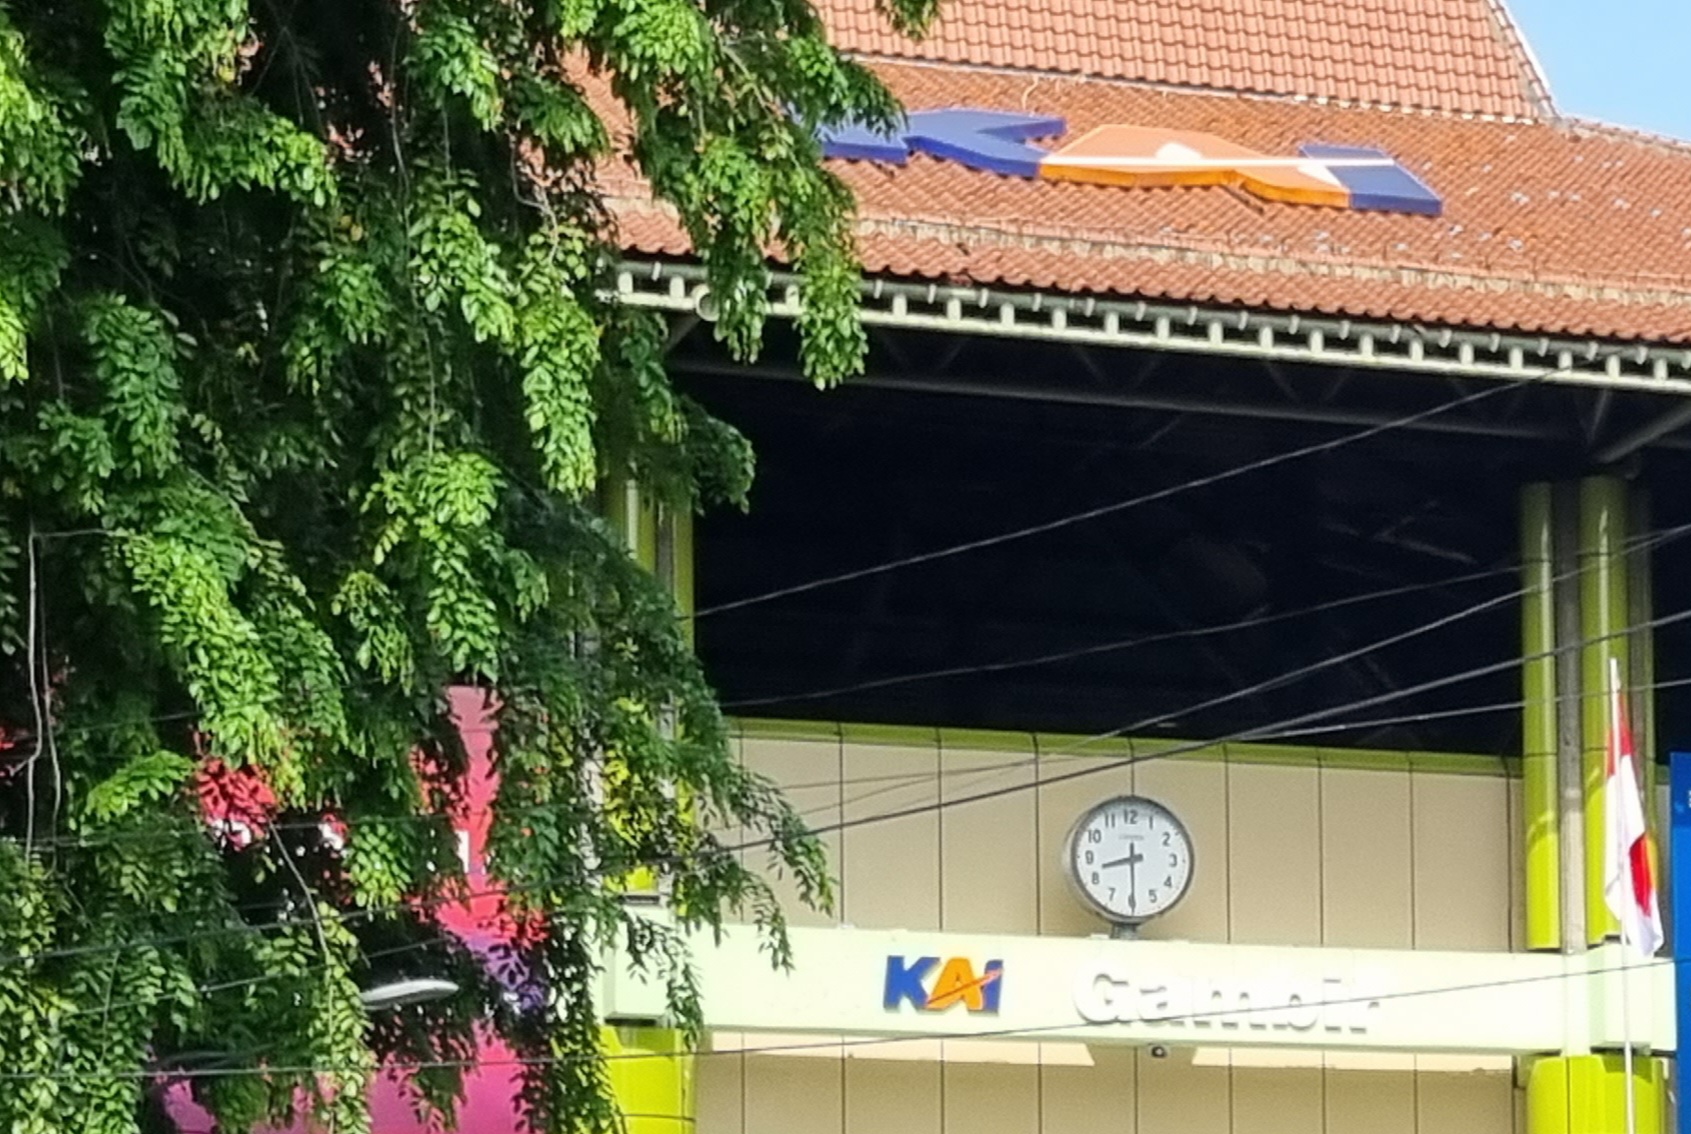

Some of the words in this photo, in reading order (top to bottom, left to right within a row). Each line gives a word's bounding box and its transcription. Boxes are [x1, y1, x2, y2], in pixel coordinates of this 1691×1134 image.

[1104, 813, 1116, 828] 11
[1124, 808, 1138, 825] 12
[1148, 815, 1154, 829] 1
[1088, 828, 1101, 843] 10
[1162, 831, 1171, 846] 2
[1085, 849, 1094, 865] 9
[1169, 853, 1178, 868] 3
[1091, 871, 1100, 885] 8
[1163, 875, 1172, 889] 4
[1108, 887, 1116, 901] 7
[1148, 888, 1158, 903] 5
[883, 955, 1004, 1017] KAI
